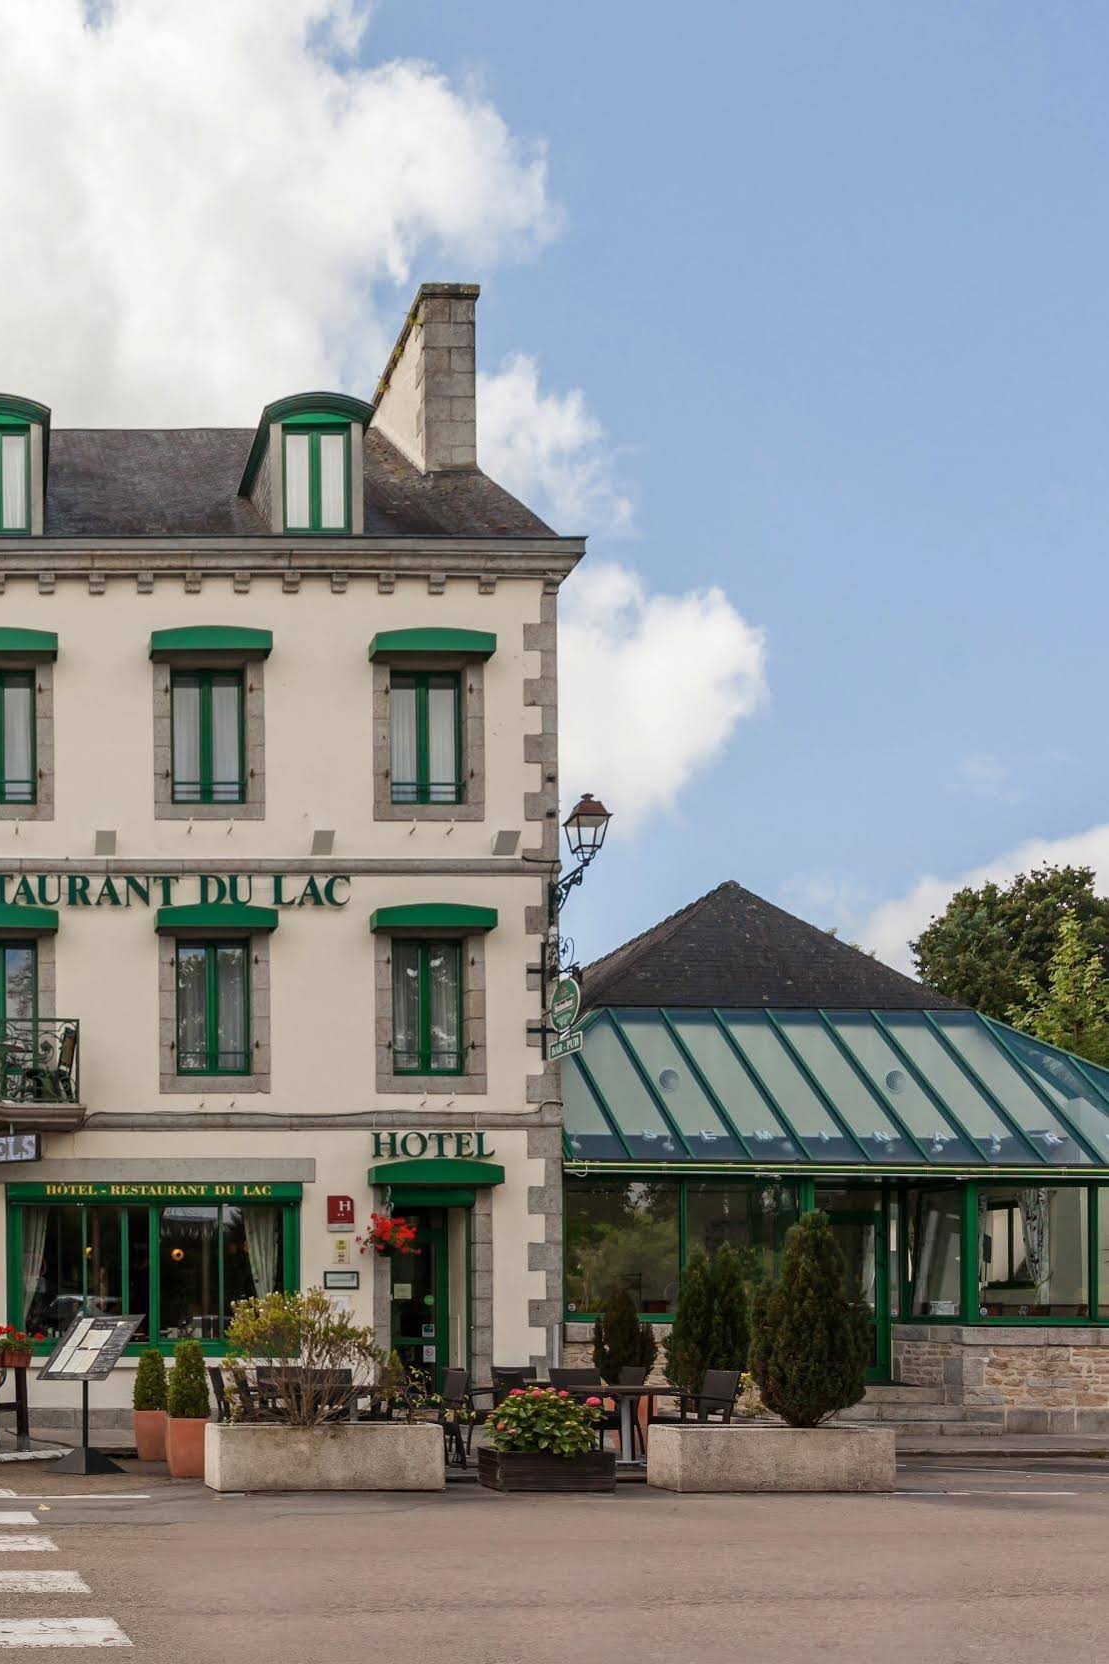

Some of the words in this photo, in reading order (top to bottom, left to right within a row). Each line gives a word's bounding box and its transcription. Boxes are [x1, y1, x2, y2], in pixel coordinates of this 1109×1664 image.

[197, 873, 253, 906] DU
[271, 873, 352, 907] LAC
[551, 1044, 563, 1057] BAR
[566, 1037, 580, 1051] PUB
[371, 1132, 496, 1158] HOTEL
[46, 1182, 97, 1196] HÔTEL
[111, 1184, 207, 1196] RESTAURANT
[214, 1184, 236, 1196] DU
[243, 1184, 272, 1196] LAC
[339, 1200, 351, 1212] H
